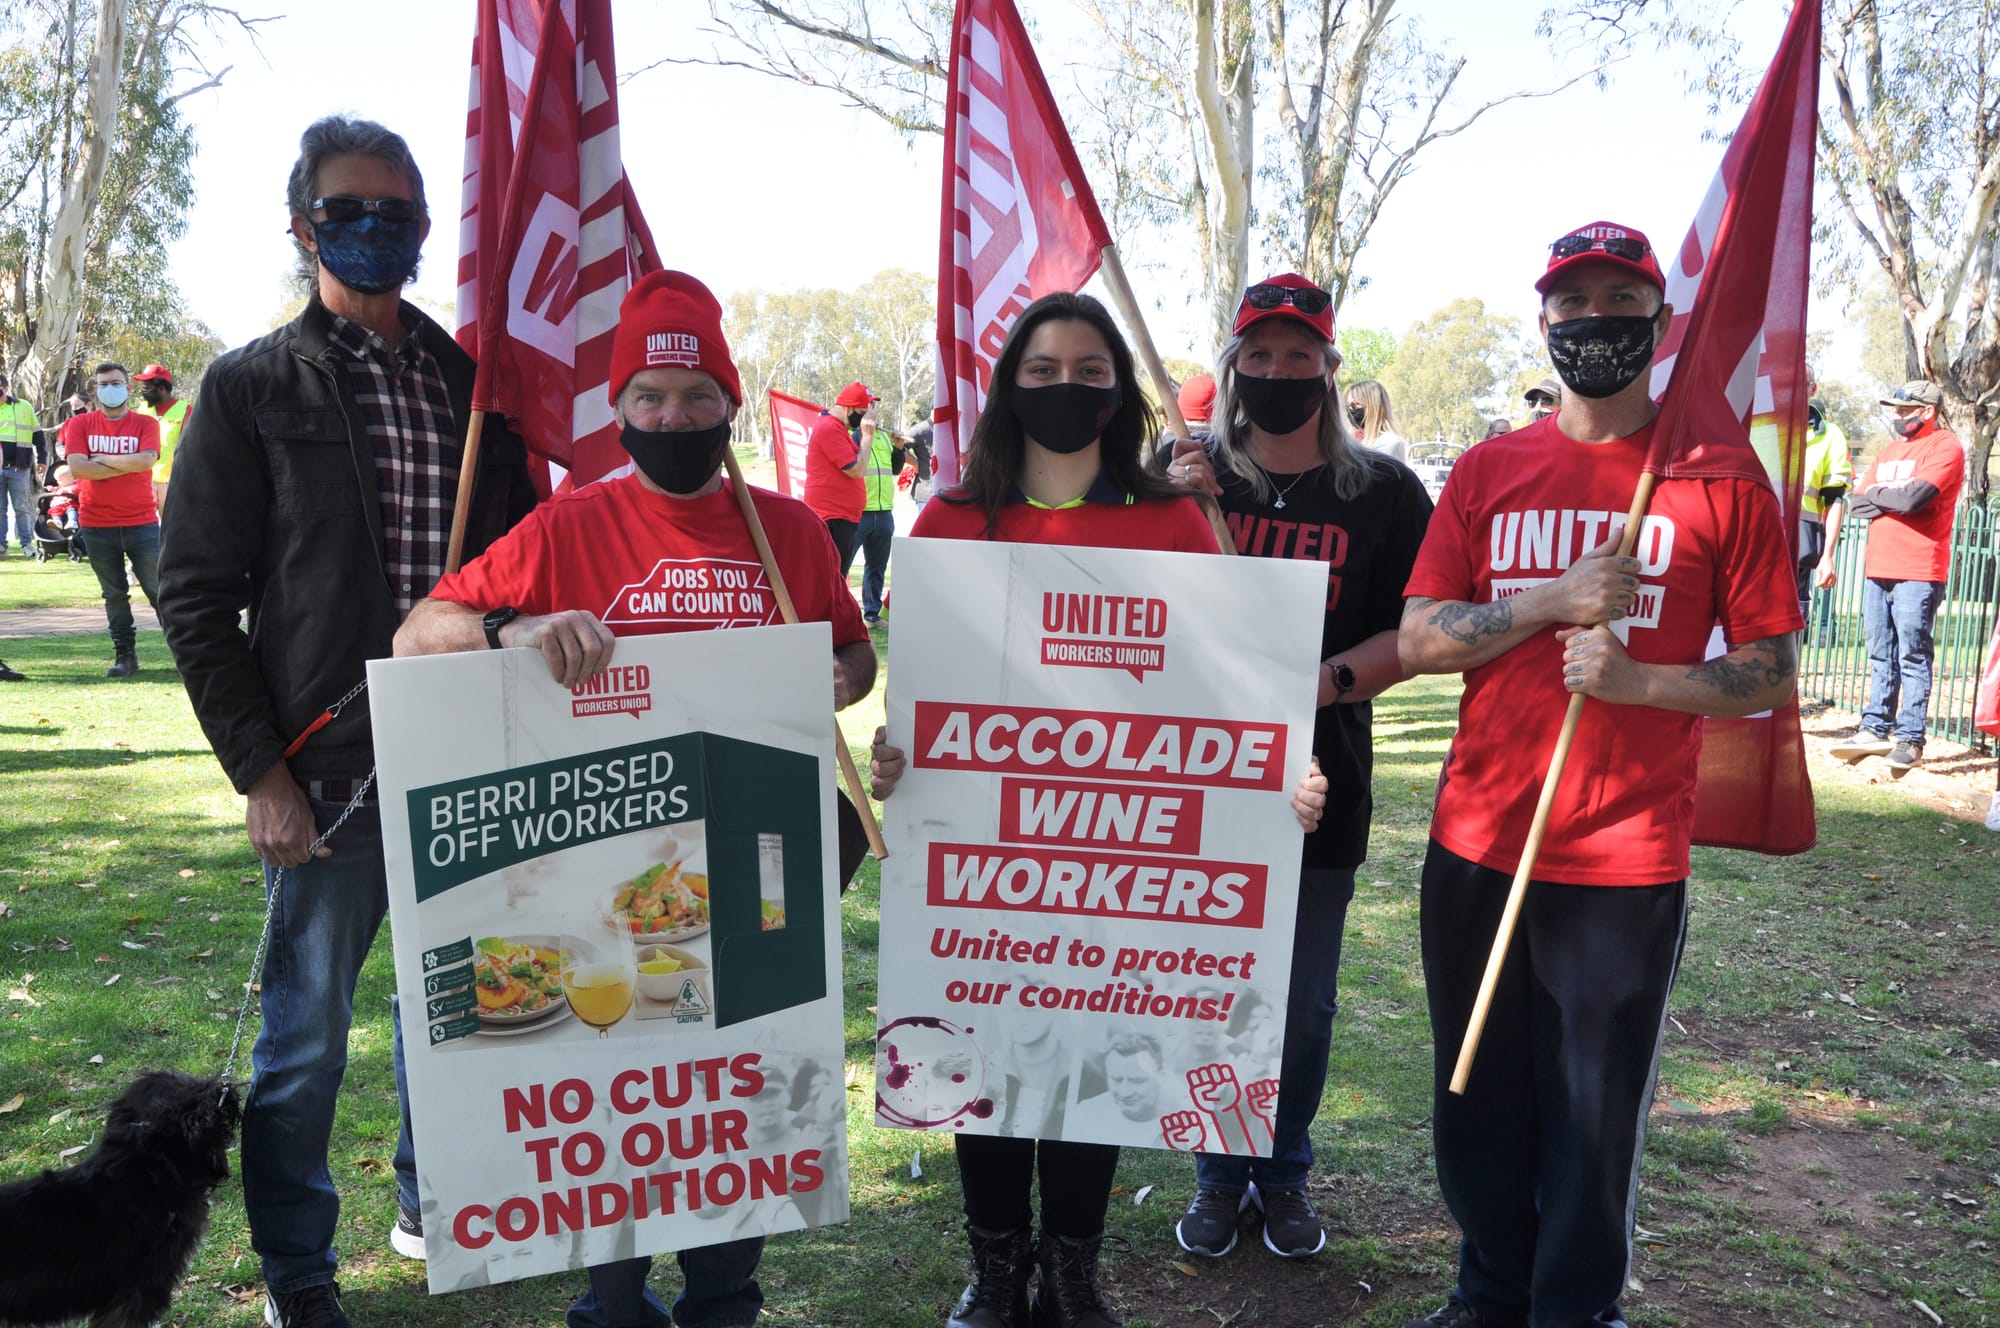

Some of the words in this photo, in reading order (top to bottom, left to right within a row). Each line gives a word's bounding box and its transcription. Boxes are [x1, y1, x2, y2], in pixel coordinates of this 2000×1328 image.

[1576, 226, 1627, 240] NITED
[647, 333, 698, 352] UNITED
[88, 434, 139, 454] UNITED
[1226, 512, 1350, 569] NITED
[628, 592, 667, 614] CAN
[672, 592, 734, 614] COUNT
[739, 593, 764, 613] ON
[661, 568, 709, 589] JOBS
[712, 568, 748, 589] YOU
[1042, 592, 1168, 639] UNITED
[1046, 643, 1113, 664] WORKERS
[1116, 647, 1160, 667] UNION
[575, 699, 619, 714] WORKERS
[620, 696, 648, 710] UNION
[926, 711, 1276, 781] ACCOLADE
[430, 776, 536, 831] BERRI
[550, 750, 675, 806] PISSED
[428, 822, 500, 867] OFF
[511, 784, 690, 850] WORKERS
[1018, 787, 1184, 846] WINE
[943, 853, 1251, 920] WORKERS
[930, 928, 1061, 966] United
[1067, 938, 1105, 968] to
[1111, 947, 1256, 980] protect
[677, 1015, 703, 1024] CAUTION
[945, 980, 1011, 1006] our
[1018, 982, 1236, 1023] conditions!
[502, 1078, 594, 1133] NO
[609, 1052, 765, 1116] CUTS
[524, 1131, 606, 1184] TO
[620, 1108, 749, 1168] OUR
[452, 1148, 825, 1250] CONDITIONS
